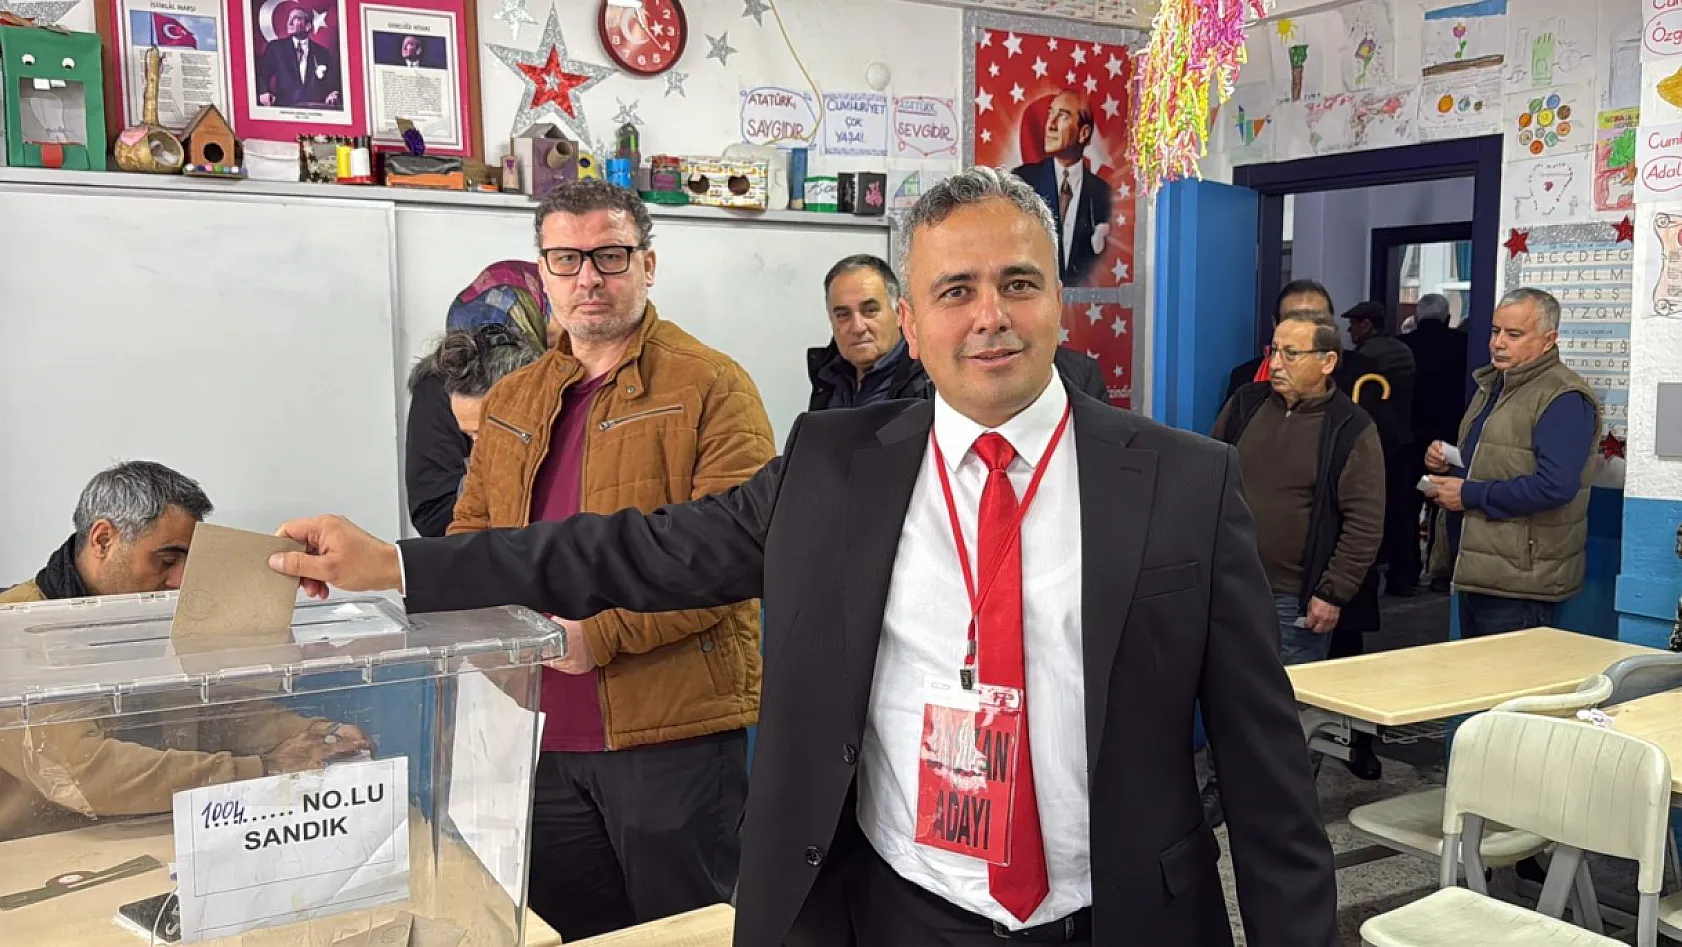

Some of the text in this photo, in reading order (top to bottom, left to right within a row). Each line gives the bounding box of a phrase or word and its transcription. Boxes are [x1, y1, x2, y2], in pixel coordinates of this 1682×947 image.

[303, 783, 384, 813] NO.LU
[244, 816, 348, 850] SANDIK
[934, 789, 992, 850] ADAYI
